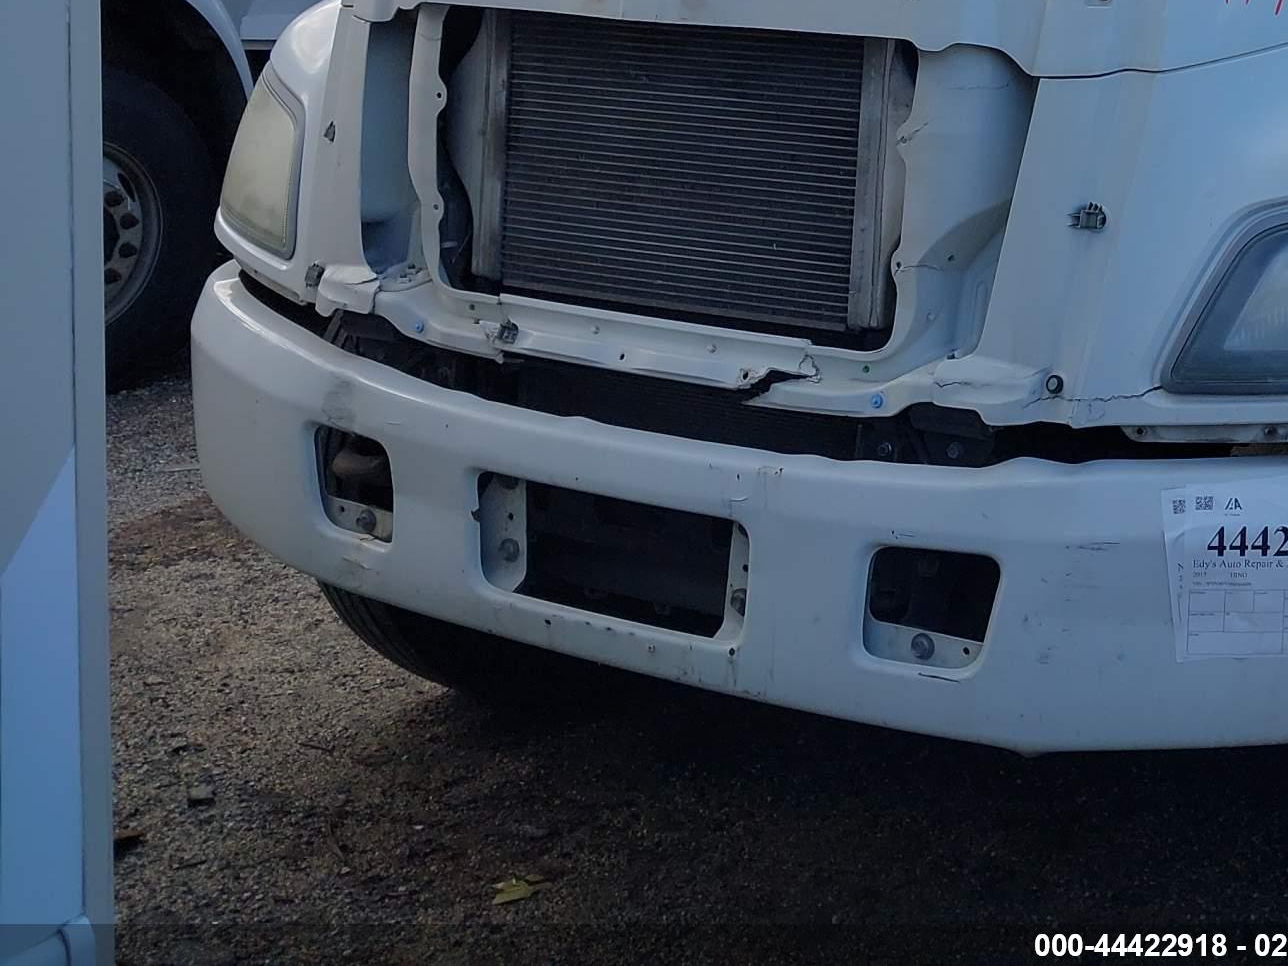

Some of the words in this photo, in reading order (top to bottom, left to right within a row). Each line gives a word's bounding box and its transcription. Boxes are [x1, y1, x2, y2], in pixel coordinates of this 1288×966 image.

[1193, 559, 1217, 570] Edy's
[1219, 559, 1242, 569] Auto
[1244, 559, 1273, 571] Repair
[1276, 559, 1284, 568] &
